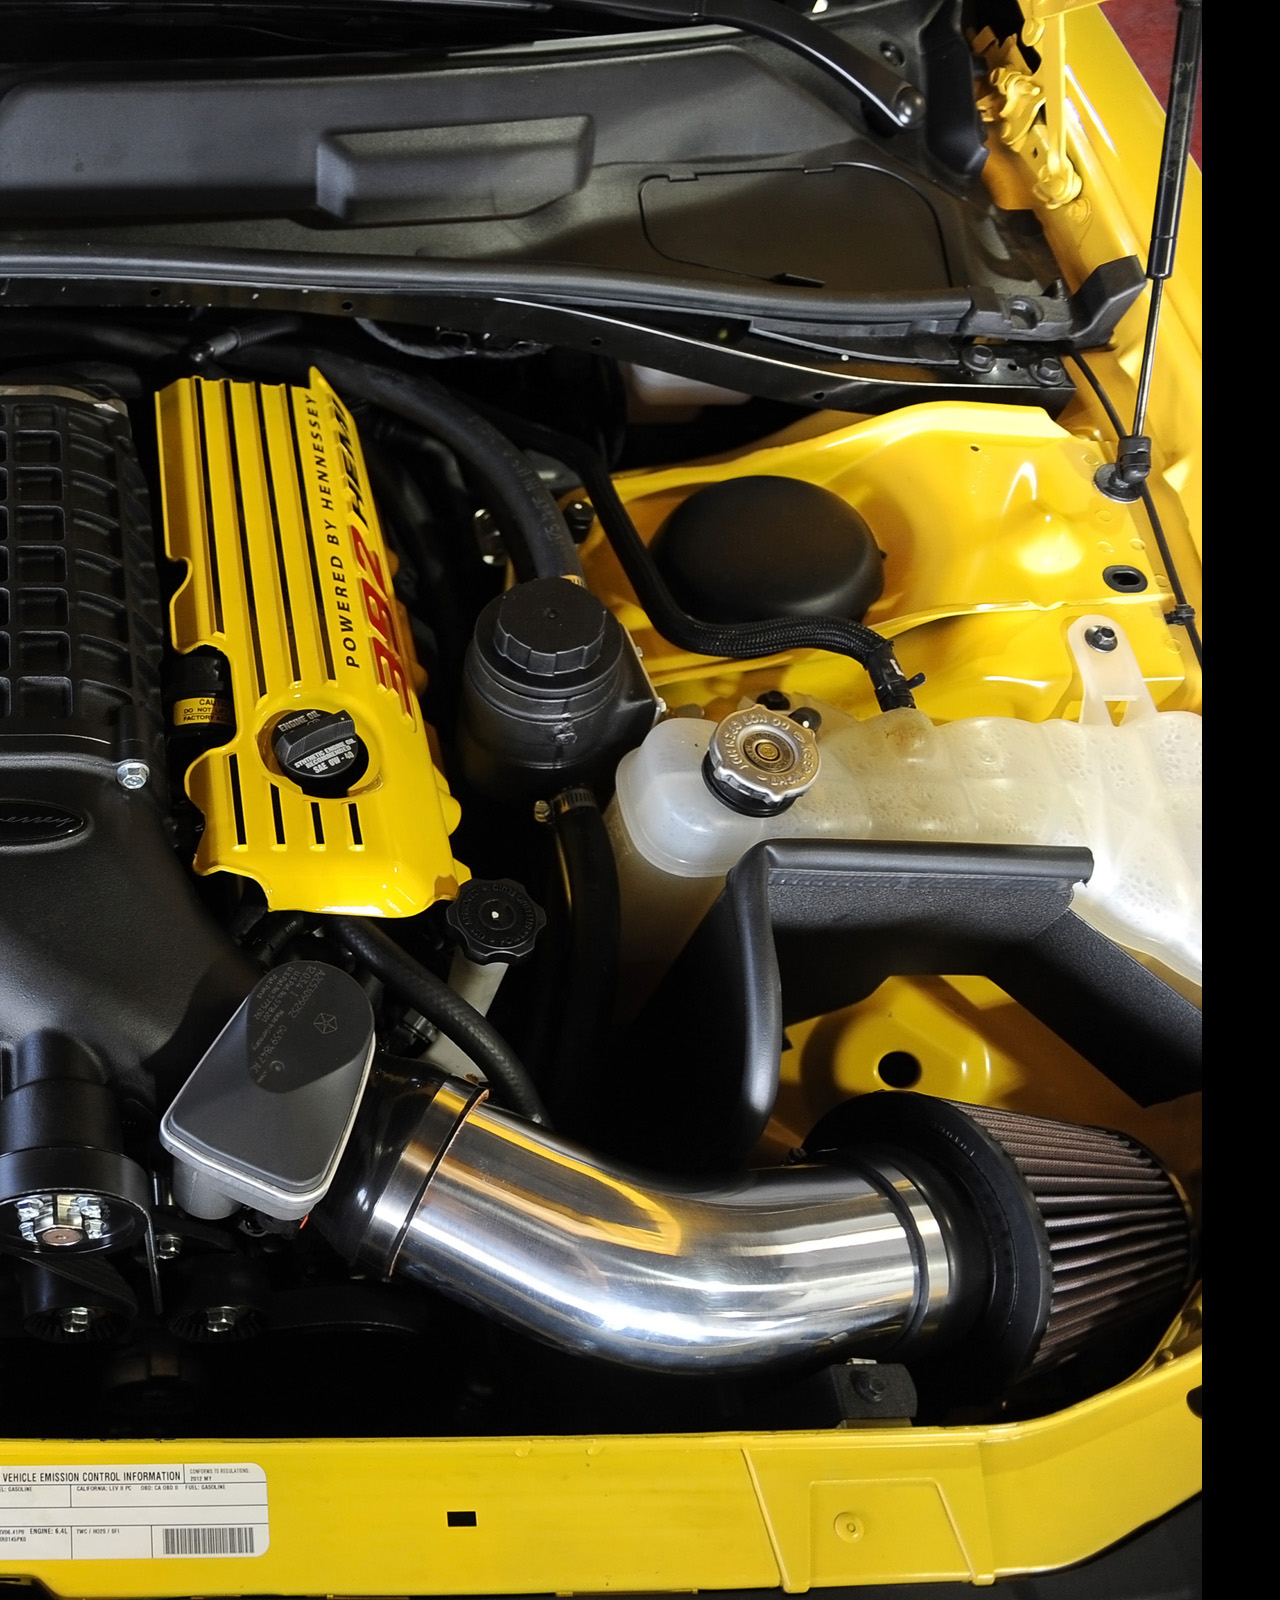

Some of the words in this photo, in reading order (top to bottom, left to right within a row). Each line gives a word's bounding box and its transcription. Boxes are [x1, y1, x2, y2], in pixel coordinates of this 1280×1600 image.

[305, 394, 333, 512] HENNESSEY
[325, 520, 340, 546] BY
[331, 556, 360, 669] POWERED
[351, 524, 412, 719] 392
[278, 716, 306, 732] ENGINE
[308, 710, 320, 720] OIL
[742, 714, 768, 726] NOT
[771, 718, 791, 732] DO
[294, 748, 324, 768] SYNTHETIC
[312, 762, 328, 774] SAE
[2, 1472, 37, 1482] VEHICLE
[40, 1472, 80, 1482] EMISSION
[82, 1472, 120, 1482] CONTROL
[124, 1471, 180, 1482] INFORMATION
